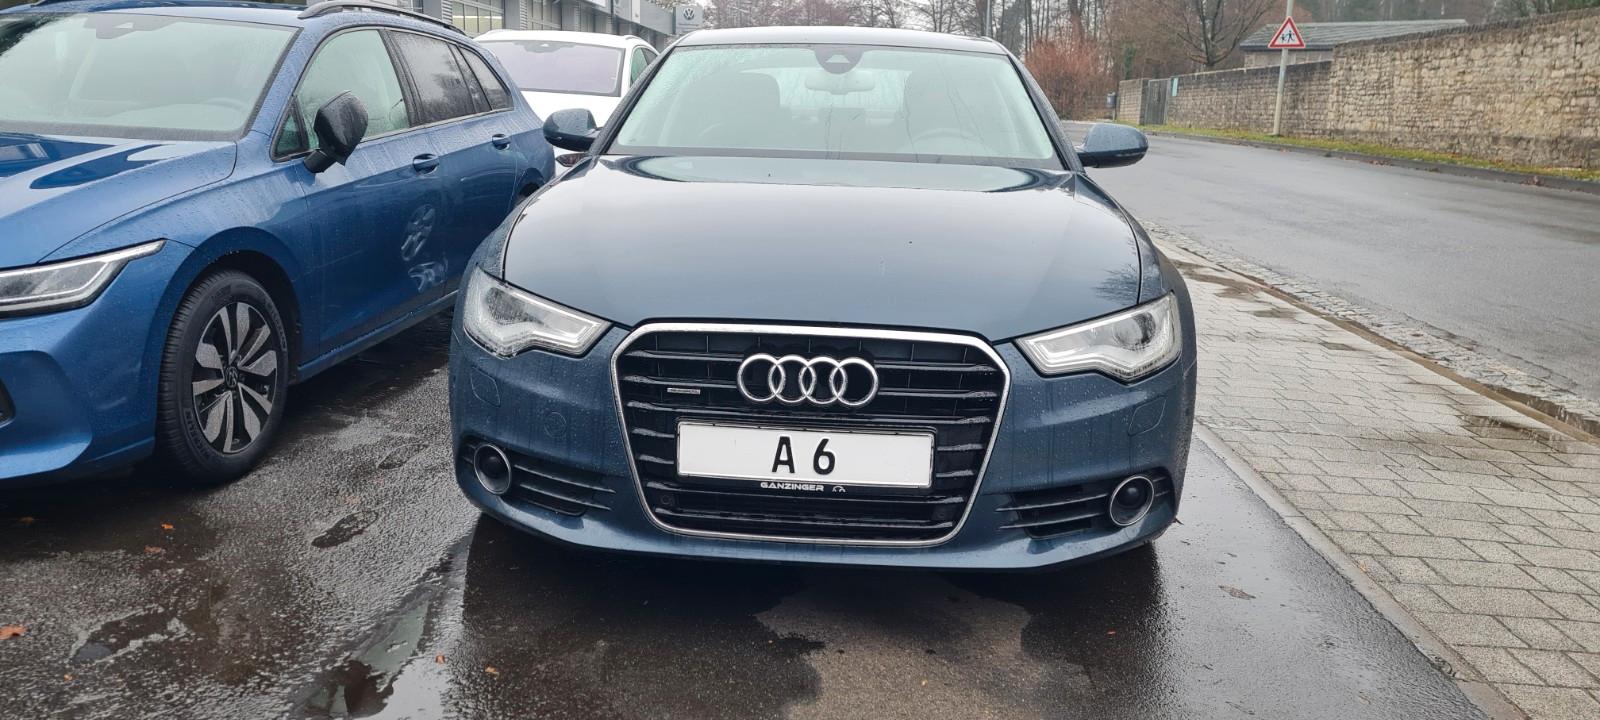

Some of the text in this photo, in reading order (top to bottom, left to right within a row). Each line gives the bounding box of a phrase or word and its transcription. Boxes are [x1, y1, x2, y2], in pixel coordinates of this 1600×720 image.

[771, 436, 836, 475] A 6
[760, 481, 825, 492] GANZINGER
